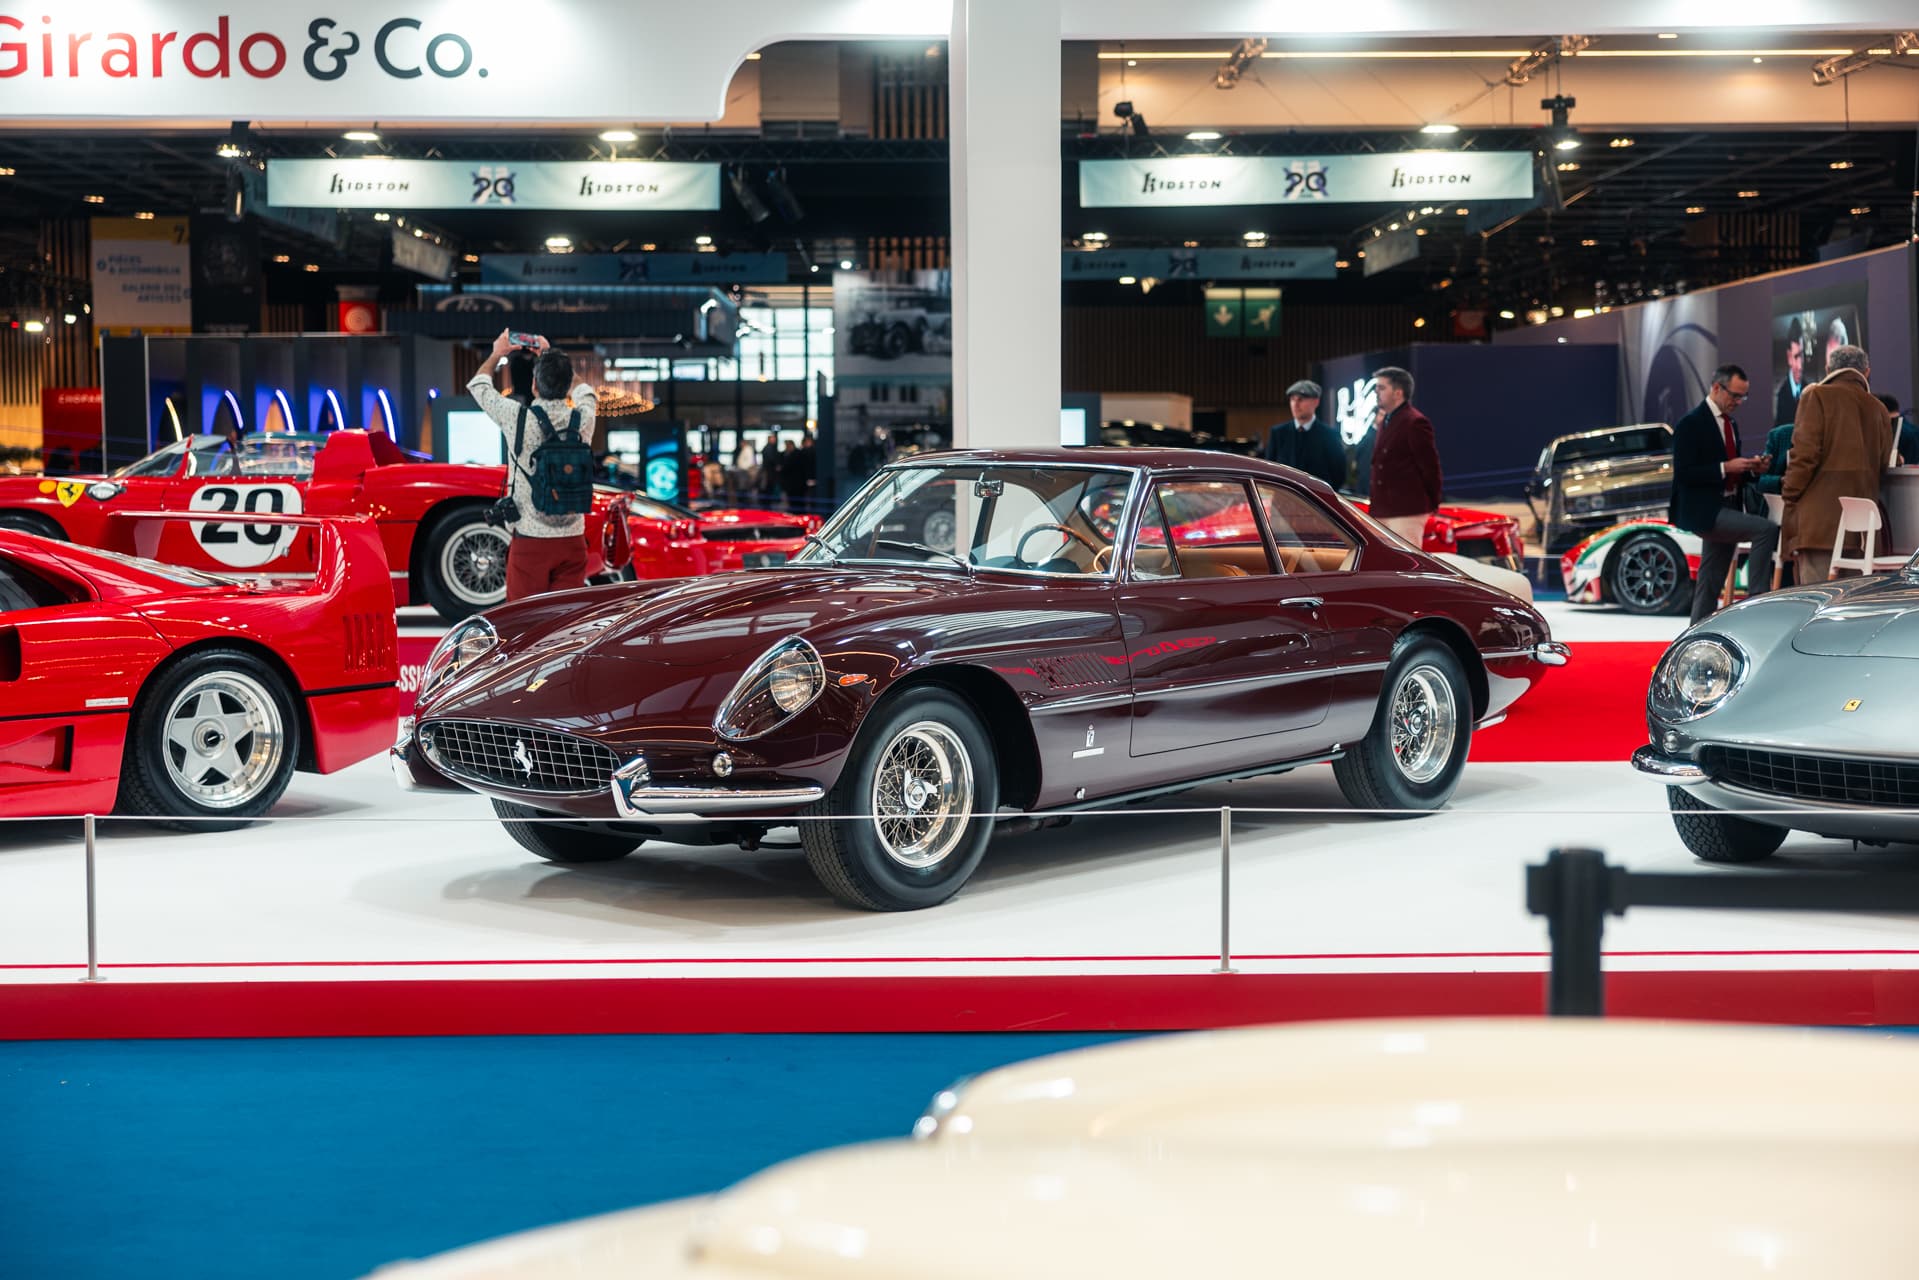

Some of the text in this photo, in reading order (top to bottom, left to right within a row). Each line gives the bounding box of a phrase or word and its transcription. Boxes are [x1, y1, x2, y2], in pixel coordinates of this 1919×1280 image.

[303, 18, 360, 81] &
[374, 18, 489, 80] Co.
[201, 488, 284, 545] 20
